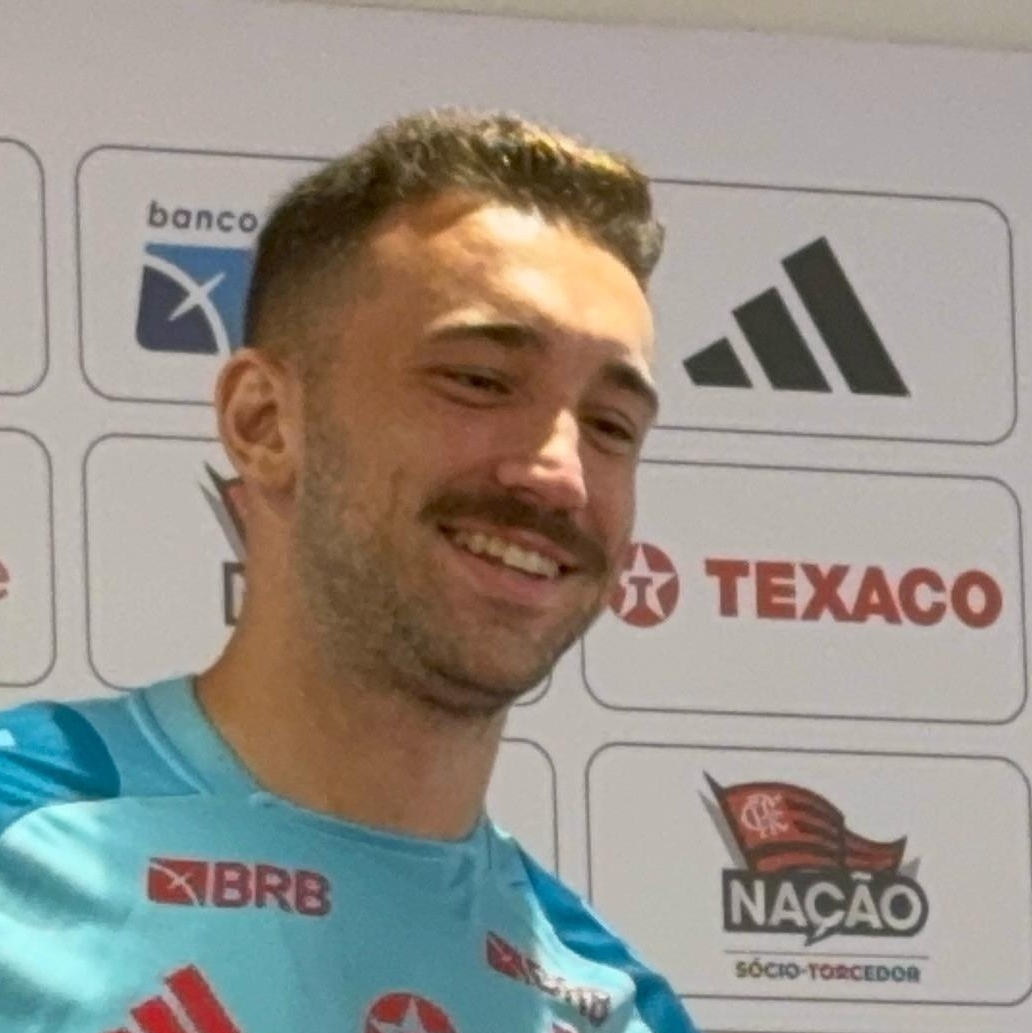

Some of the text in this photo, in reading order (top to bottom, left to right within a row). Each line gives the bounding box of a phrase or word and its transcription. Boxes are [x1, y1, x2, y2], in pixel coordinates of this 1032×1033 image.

[148, 201, 258, 233] banco
[704, 558, 1003, 629] TEXACO
[214, 862, 332, 917] BRB
[729, 872, 922, 938] NAÇÃO
